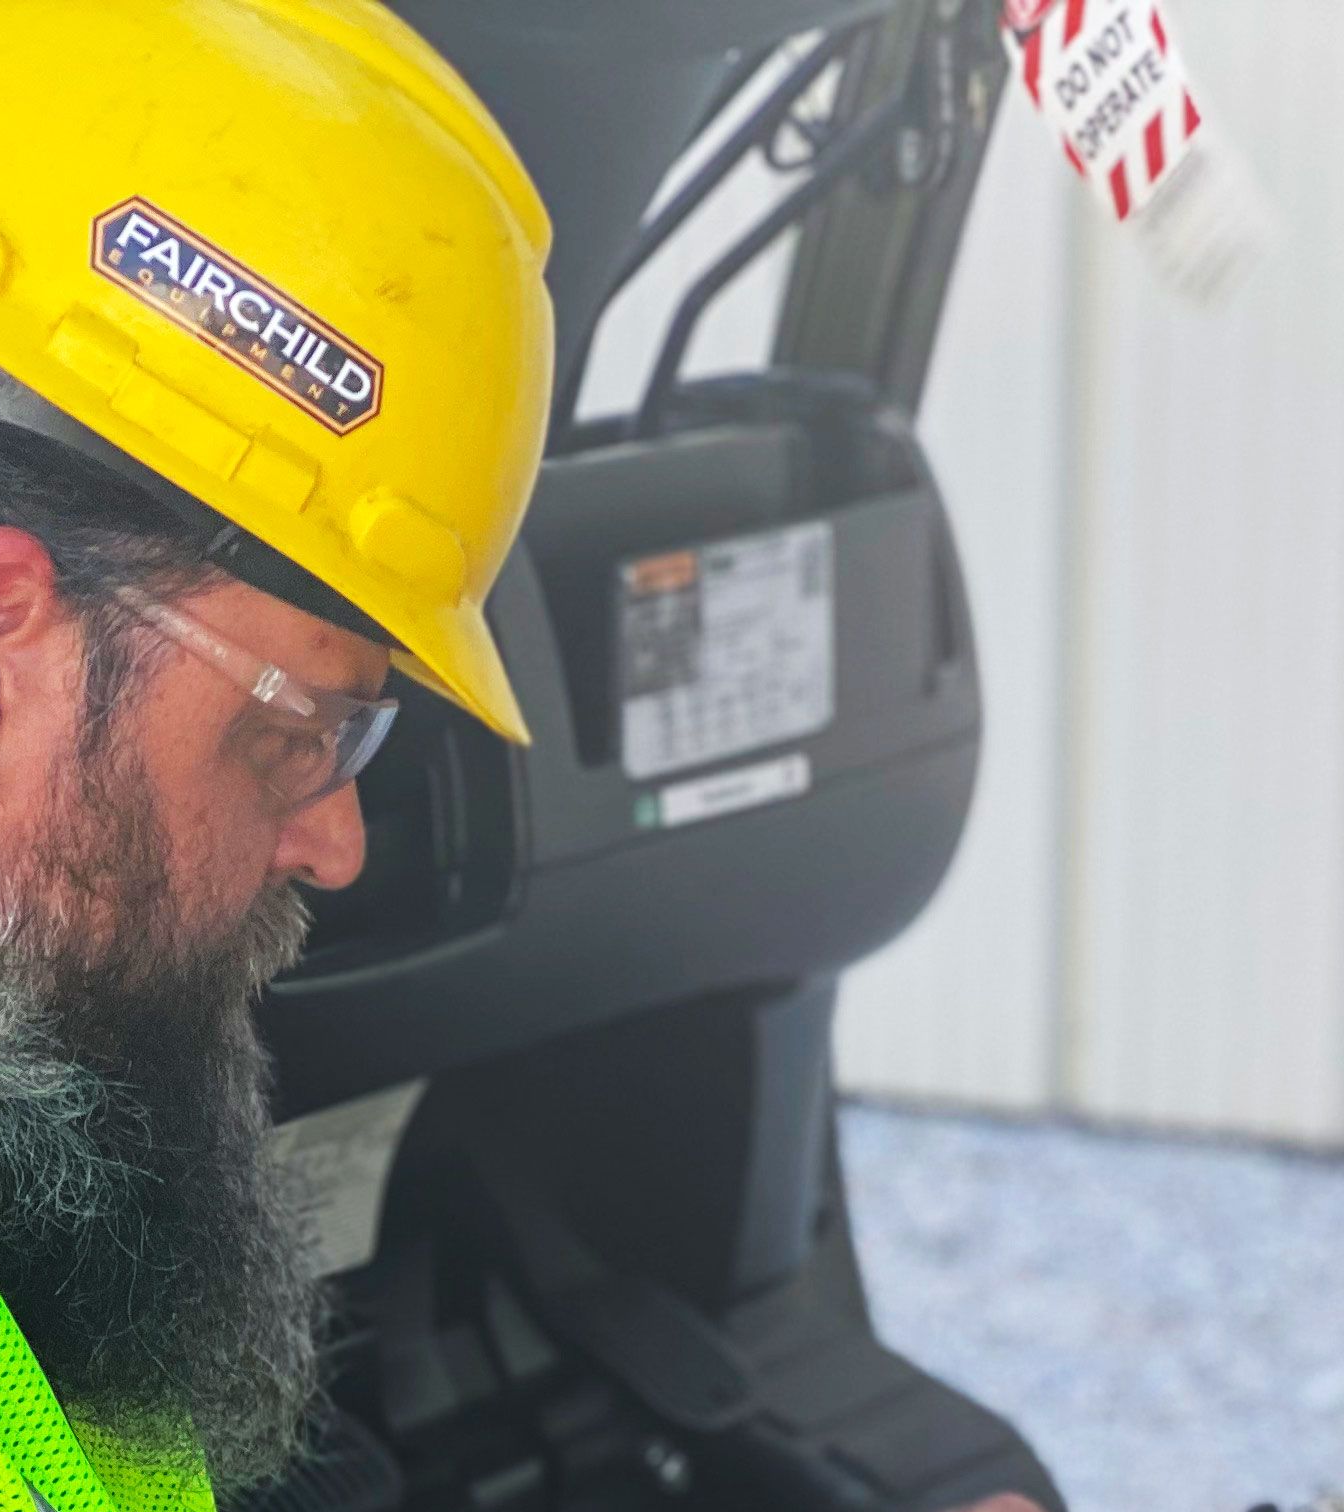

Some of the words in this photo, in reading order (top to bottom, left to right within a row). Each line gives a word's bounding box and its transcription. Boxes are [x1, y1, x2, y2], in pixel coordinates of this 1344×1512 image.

[1056, 61, 1089, 110] DO
[1087, 9, 1134, 75] NOT
[1076, 50, 1163, 159] OPERATE
[108, 248, 349, 417] EQUIPMENT
[116, 212, 371, 401] FAIRCHILD
